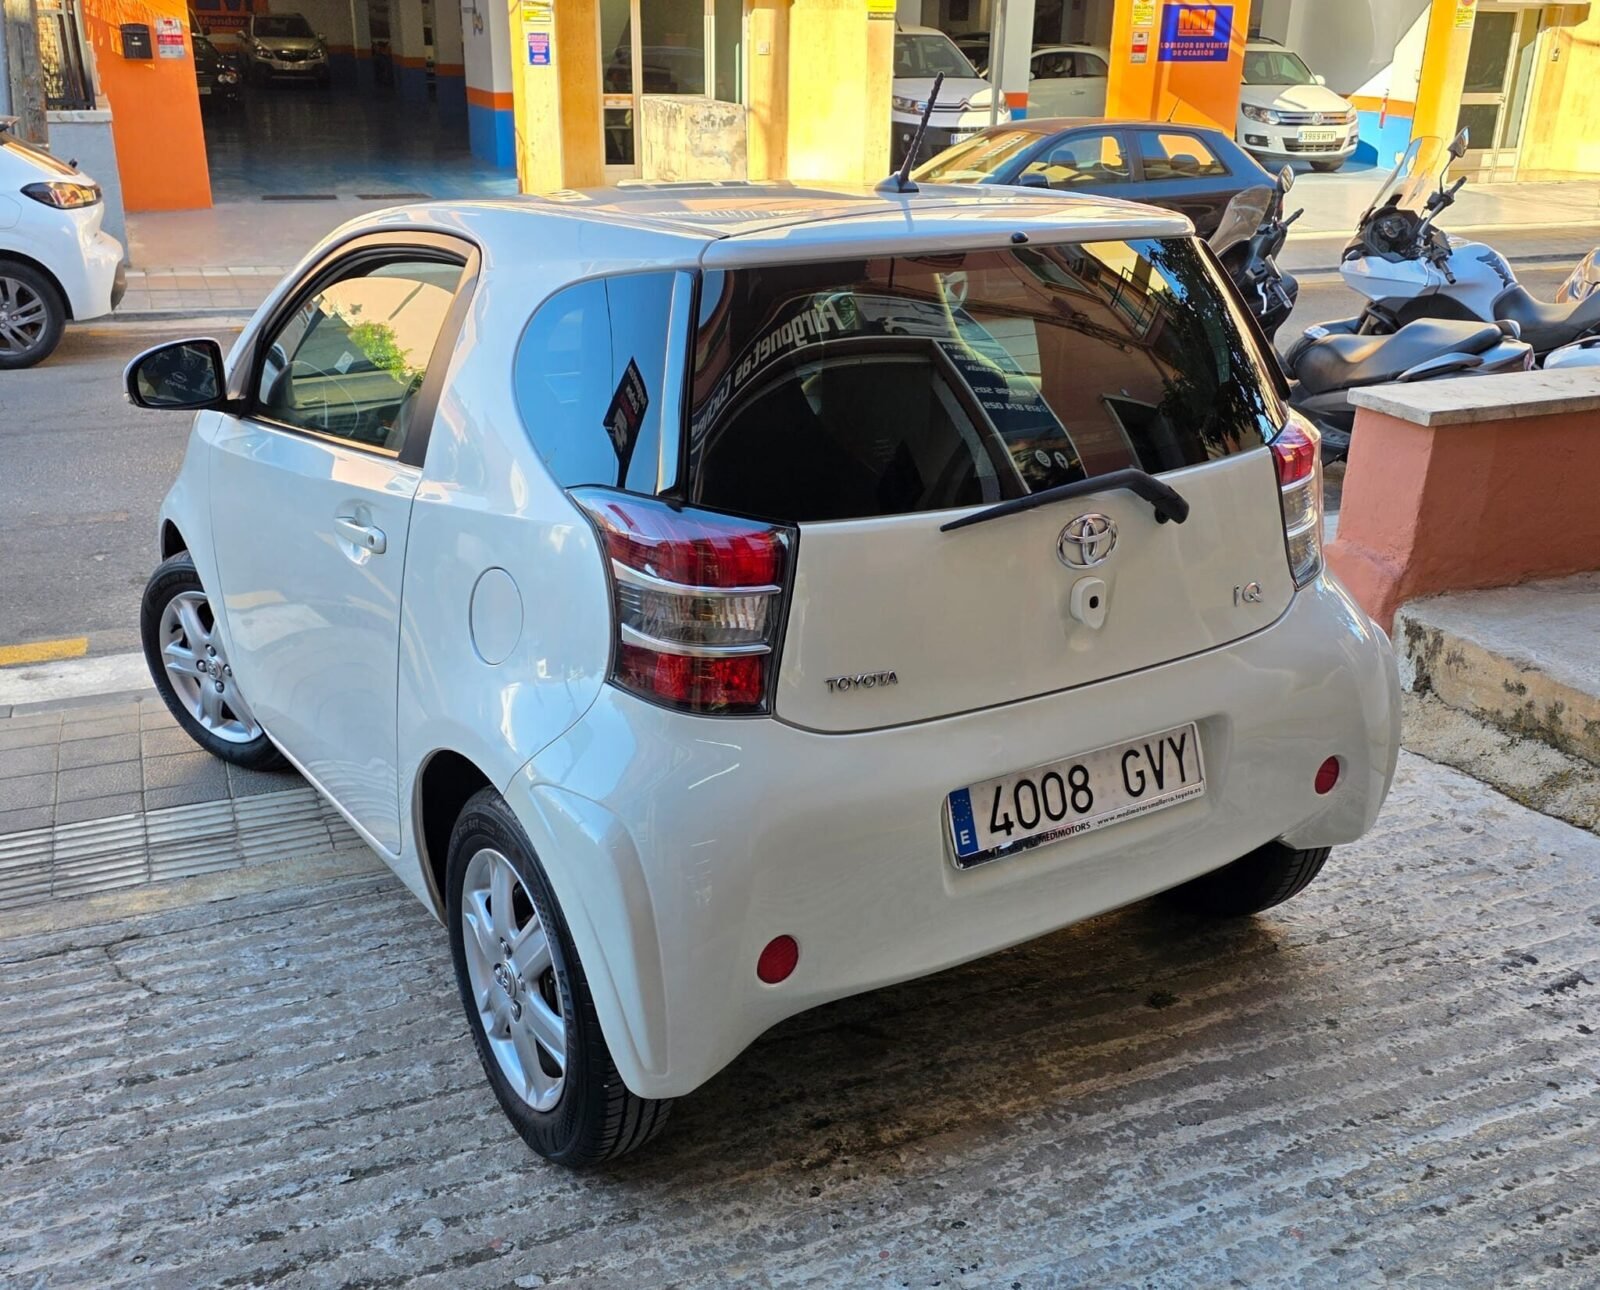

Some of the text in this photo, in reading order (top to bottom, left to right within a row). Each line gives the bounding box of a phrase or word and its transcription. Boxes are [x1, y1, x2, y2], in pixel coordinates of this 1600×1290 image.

[824, 670, 898, 693] TOYOTA
[989, 733, 1187, 837] 4008 GVY
[960, 829, 970, 845] E
